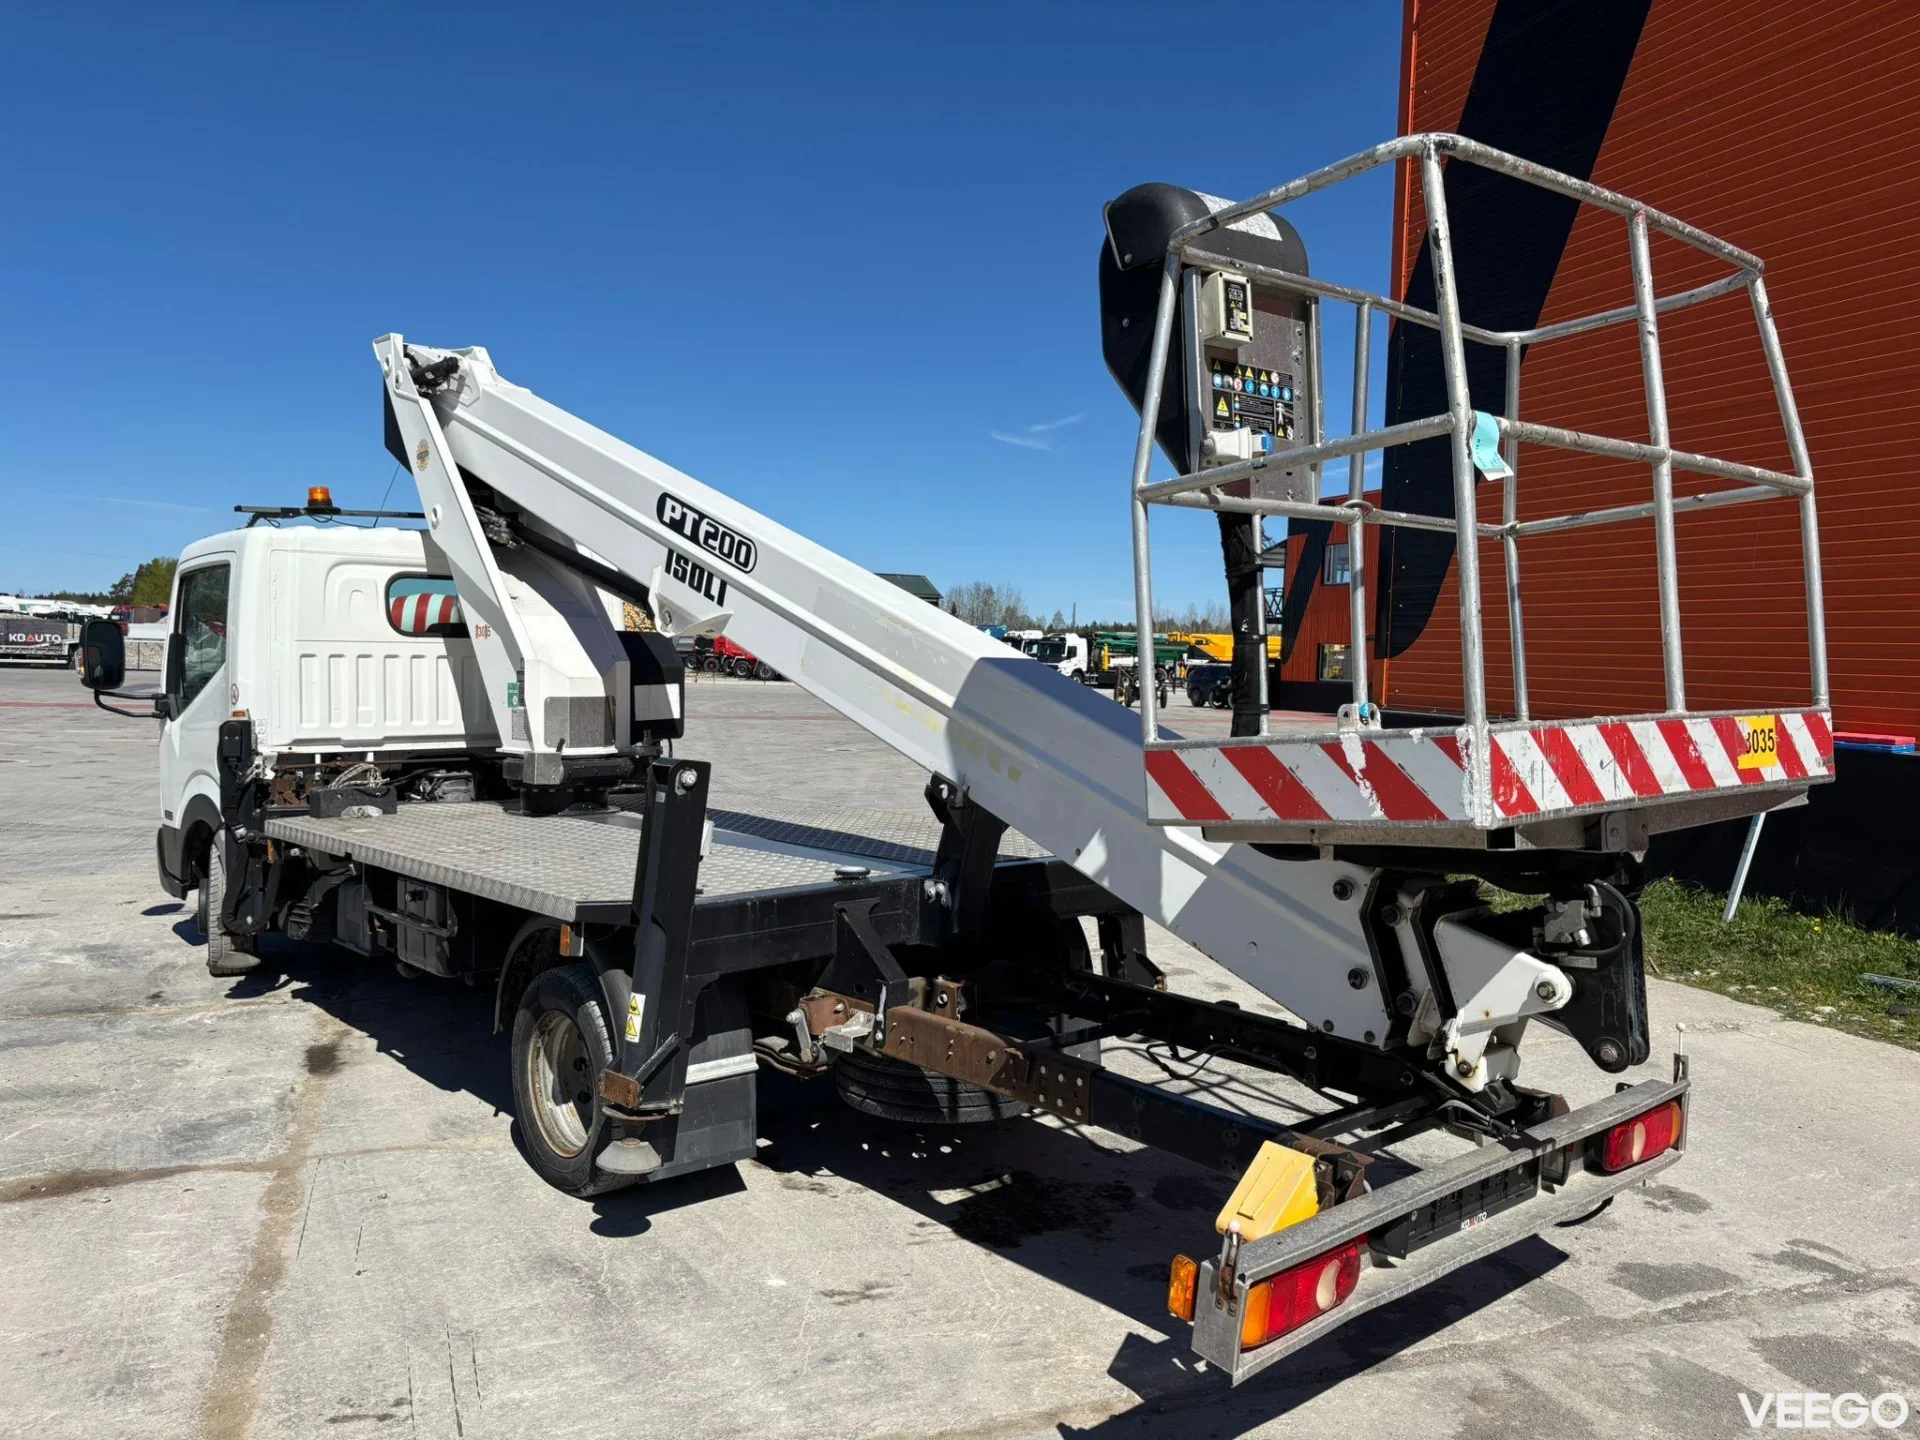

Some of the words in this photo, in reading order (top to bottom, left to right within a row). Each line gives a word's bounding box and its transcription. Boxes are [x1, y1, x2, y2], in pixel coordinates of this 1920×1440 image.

[662, 497, 752, 570] PT200
[664, 547, 728, 608] ISOLI
[8, 633, 62, 643] KBAUTO
[1745, 728, 1775, 754] 3035
